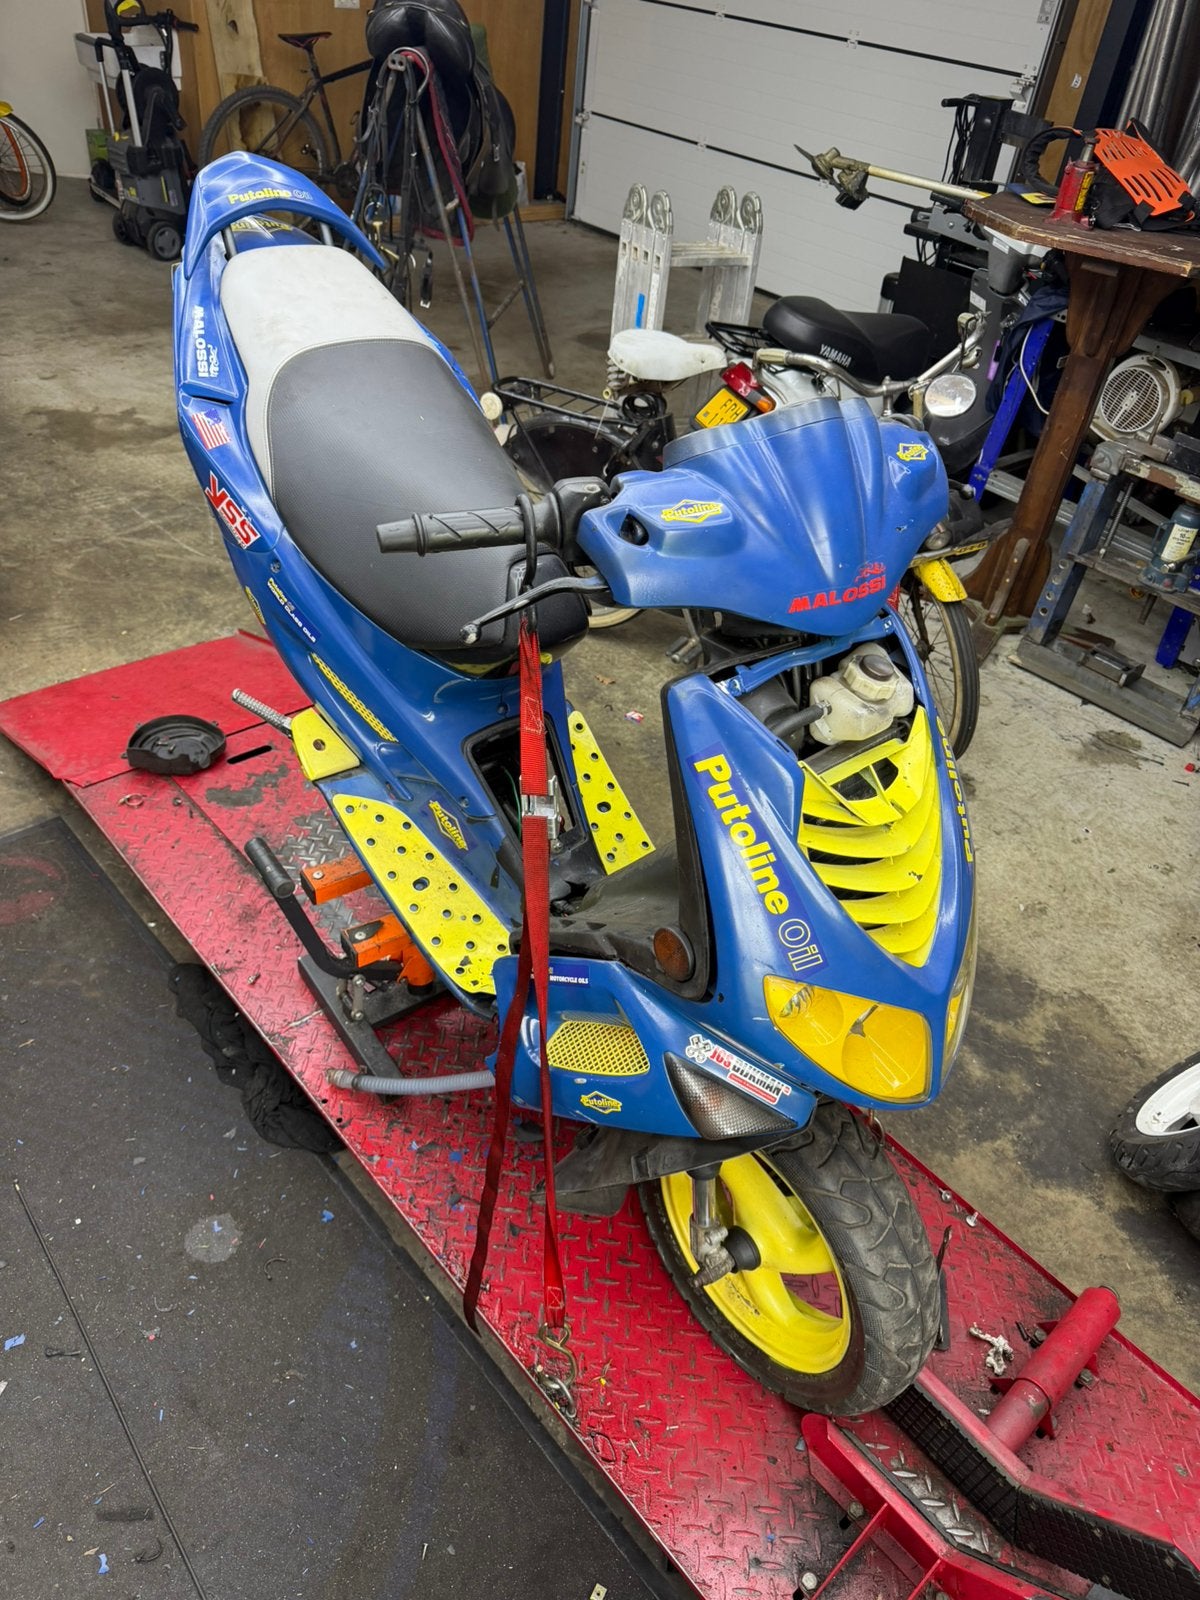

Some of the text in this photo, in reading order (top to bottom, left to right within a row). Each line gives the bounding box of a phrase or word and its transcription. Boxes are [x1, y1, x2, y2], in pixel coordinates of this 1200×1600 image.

[227, 188, 292, 205] Putoline
[191, 304, 209, 378] MALOSSI
[820, 343, 852, 368] YAMAHA
[719, 398, 744, 421] FPH
[205, 471, 260, 546] YSS
[661, 502, 718, 521] Putoline
[787, 575, 887, 614] MALOSSI
[302, 626, 317, 643] OILS
[428, 800, 467, 850] Putoline
[693, 753, 823, 972] Putoline Oil
